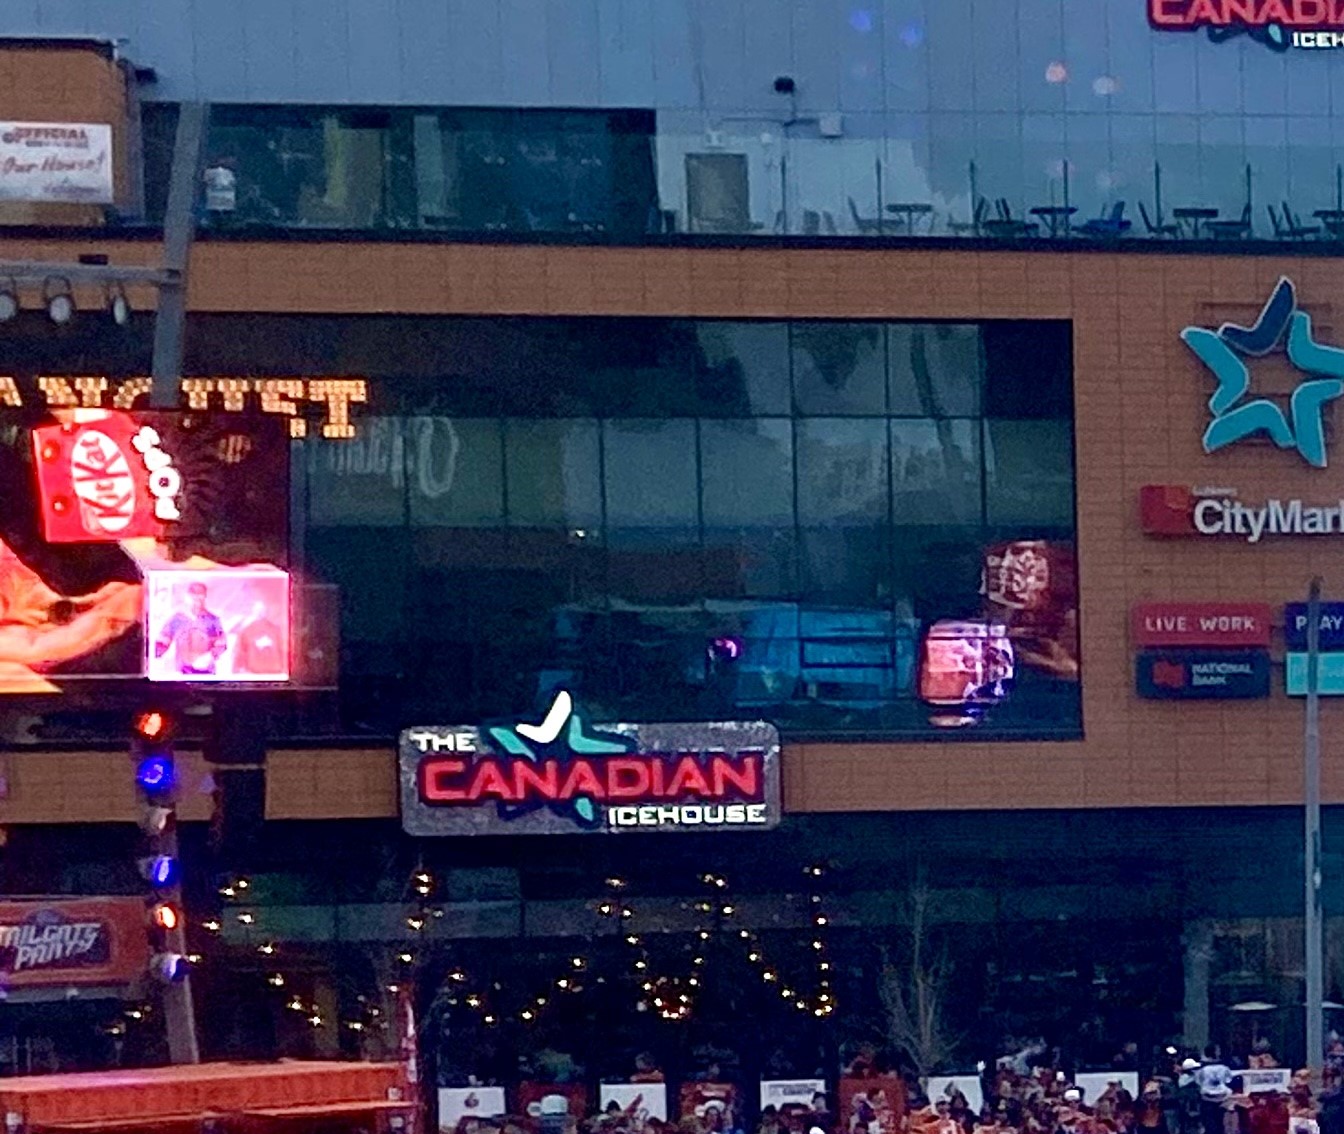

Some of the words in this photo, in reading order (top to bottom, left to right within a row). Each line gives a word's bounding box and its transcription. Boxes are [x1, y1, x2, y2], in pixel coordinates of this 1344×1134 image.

[1145, 617, 1186, 632] LIVE
[1200, 617, 1255, 632] WORK
[1295, 615, 1342, 631] PAY
[1192, 663, 1253, 675] NATIONAL
[411, 732, 476, 752] THE
[423, 757, 756, 800] CANADIAN
[608, 803, 766, 826] ICEHOUSE
